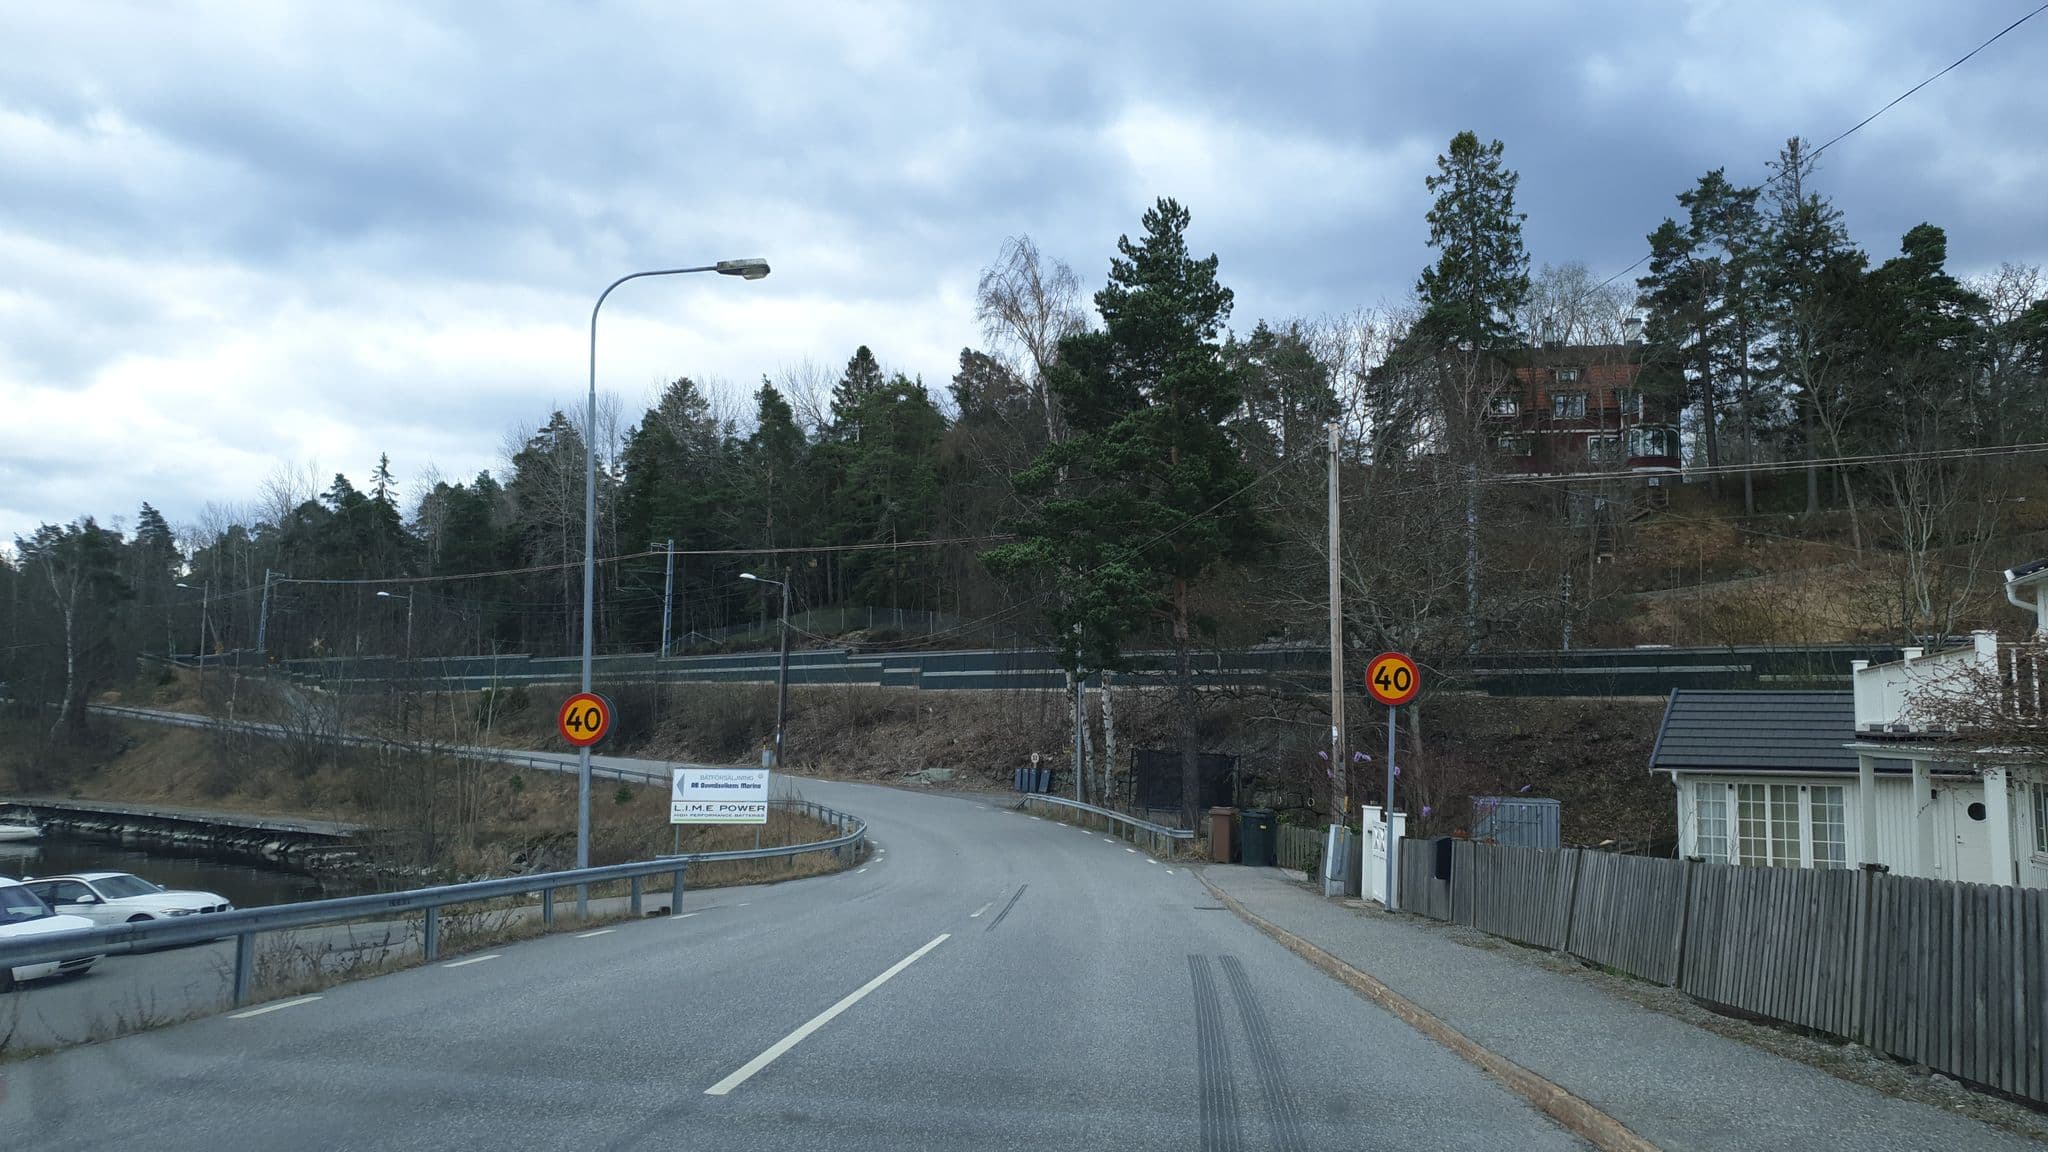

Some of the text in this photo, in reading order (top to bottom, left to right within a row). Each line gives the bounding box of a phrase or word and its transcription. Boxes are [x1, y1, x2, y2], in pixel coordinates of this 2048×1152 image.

[1374, 666, 1412, 692] 40
[566, 707, 601, 732] 40
[719, 804, 766, 812] POWER
